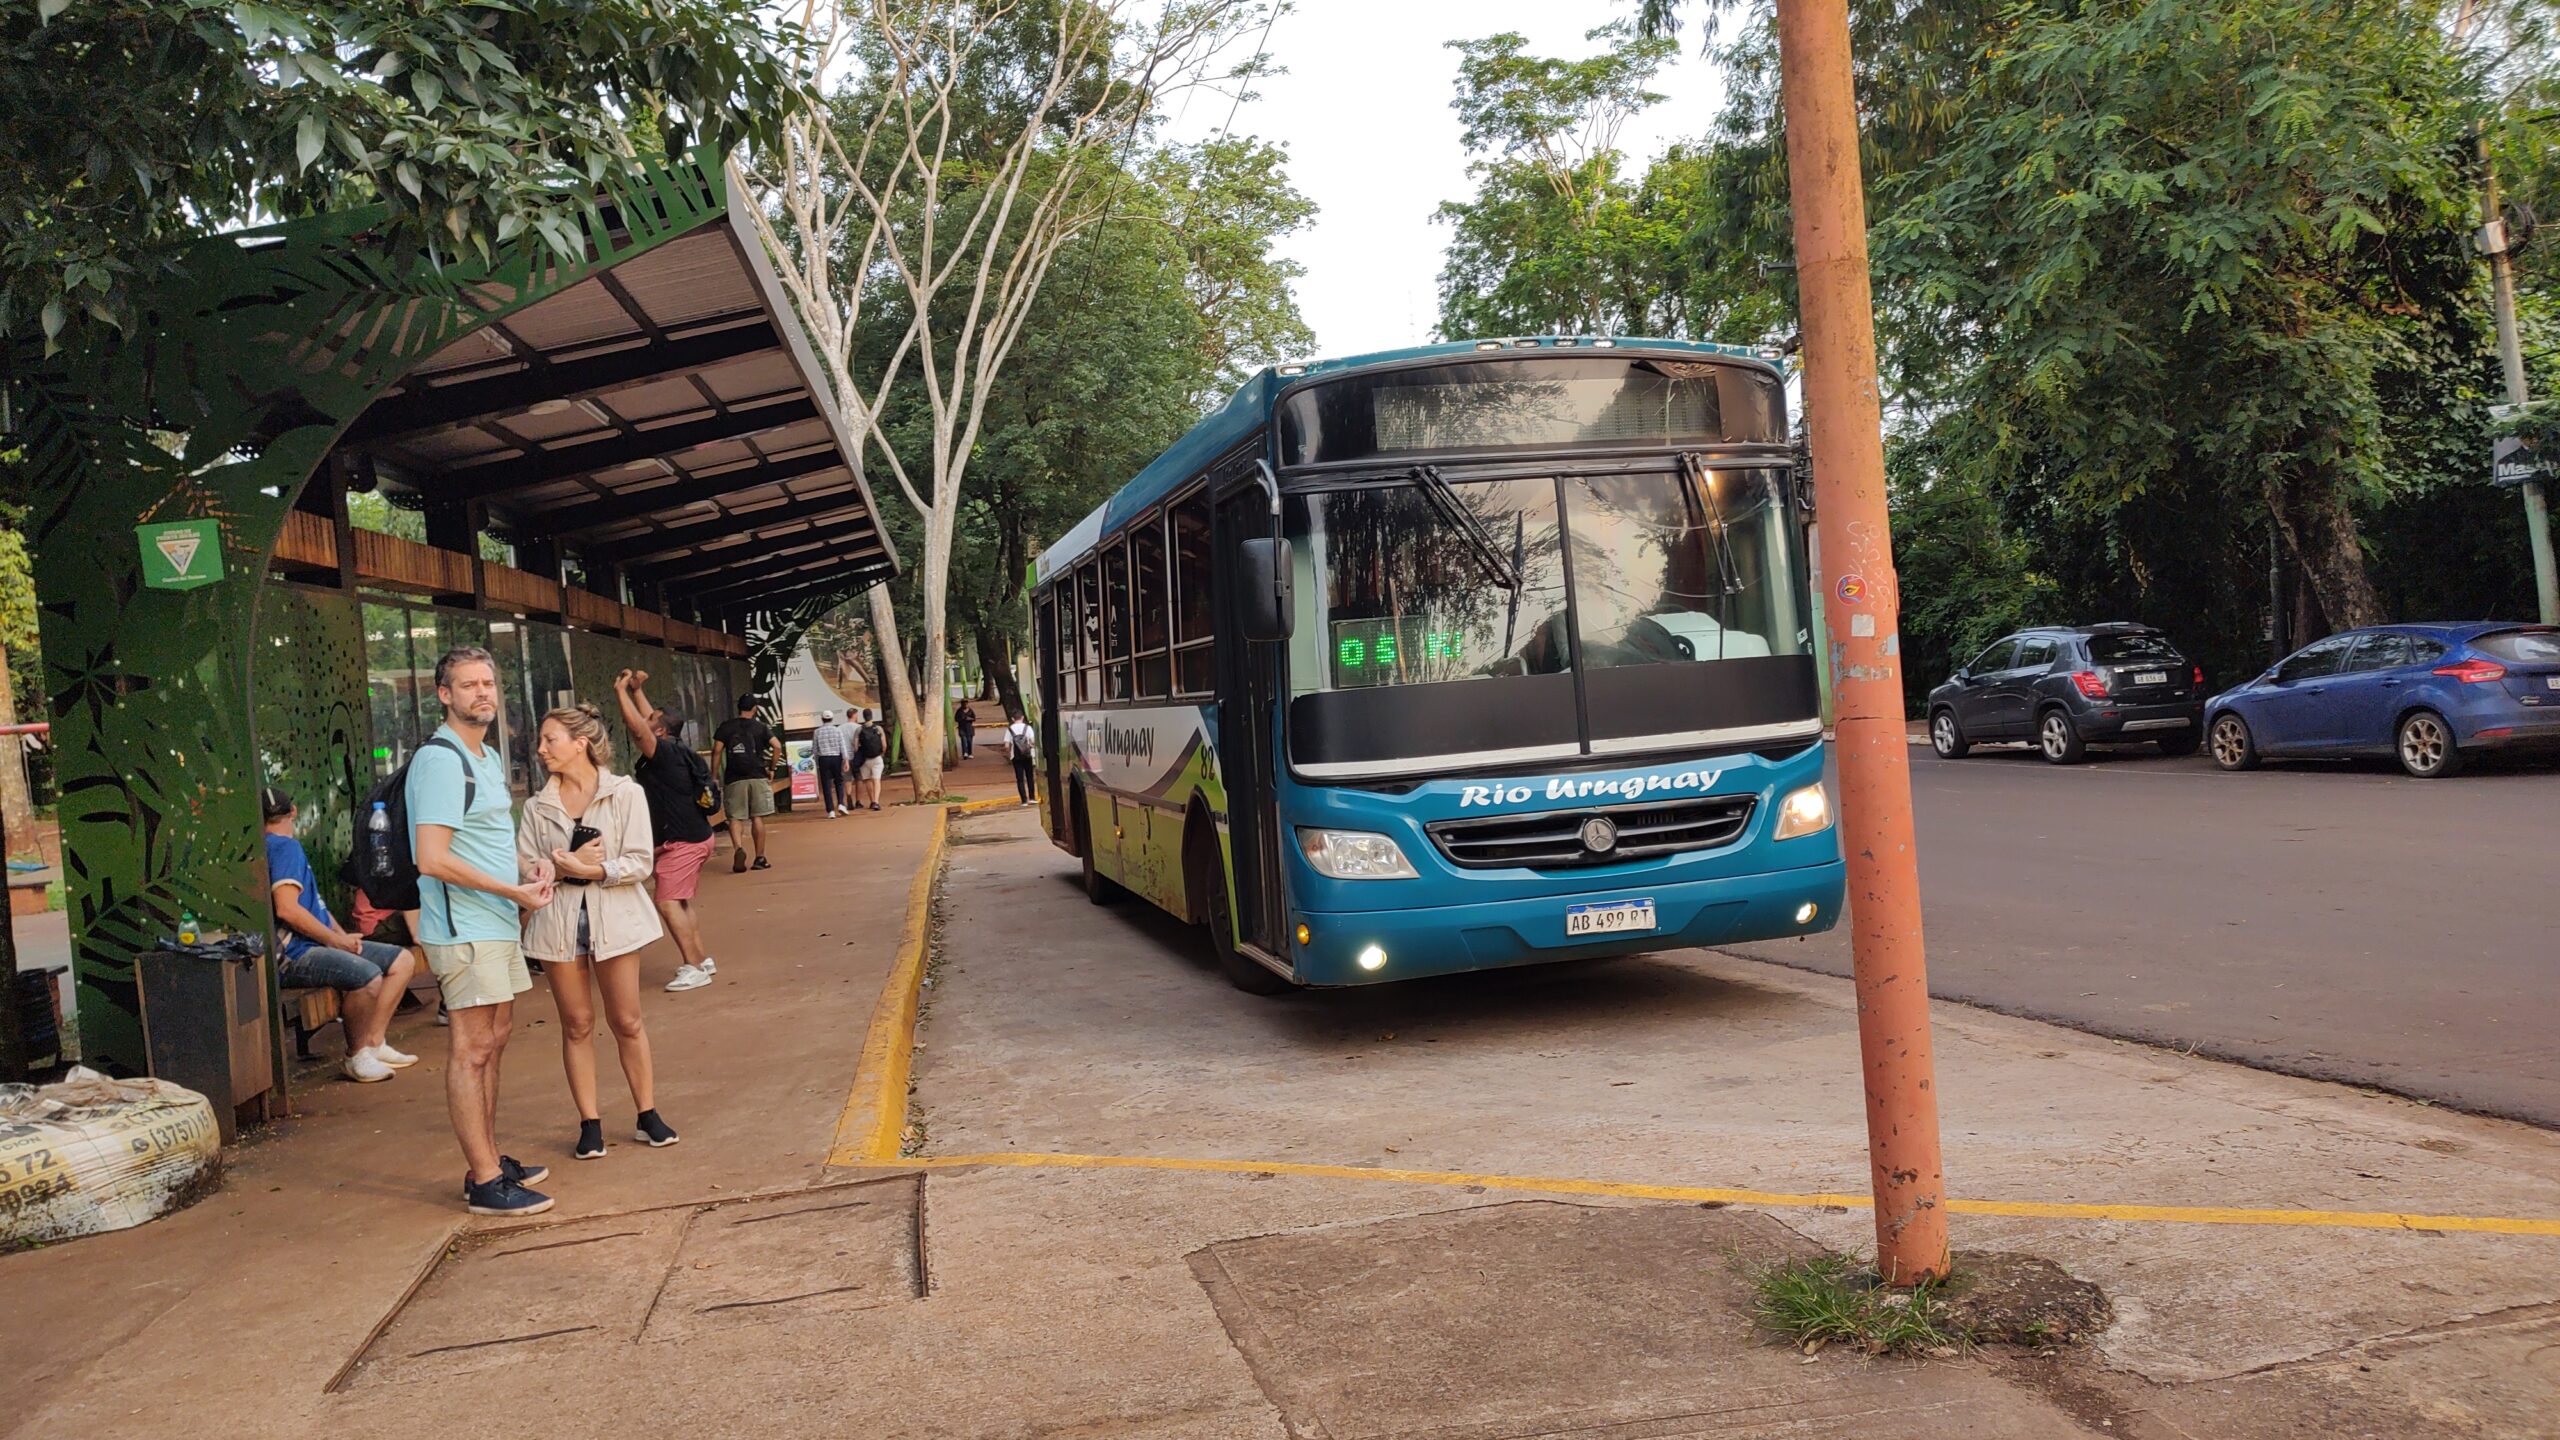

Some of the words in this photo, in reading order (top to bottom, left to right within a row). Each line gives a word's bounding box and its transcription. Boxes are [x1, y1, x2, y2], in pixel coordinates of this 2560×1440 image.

[1104, 717, 1155, 768] Uruguay
[1200, 745, 1216, 781] 82
[1459, 784, 1532, 808] Rio
[1545, 769, 1722, 800] Uruguay
[1572, 914, 1590, 932] AB
[1596, 911, 1625, 929] 499
